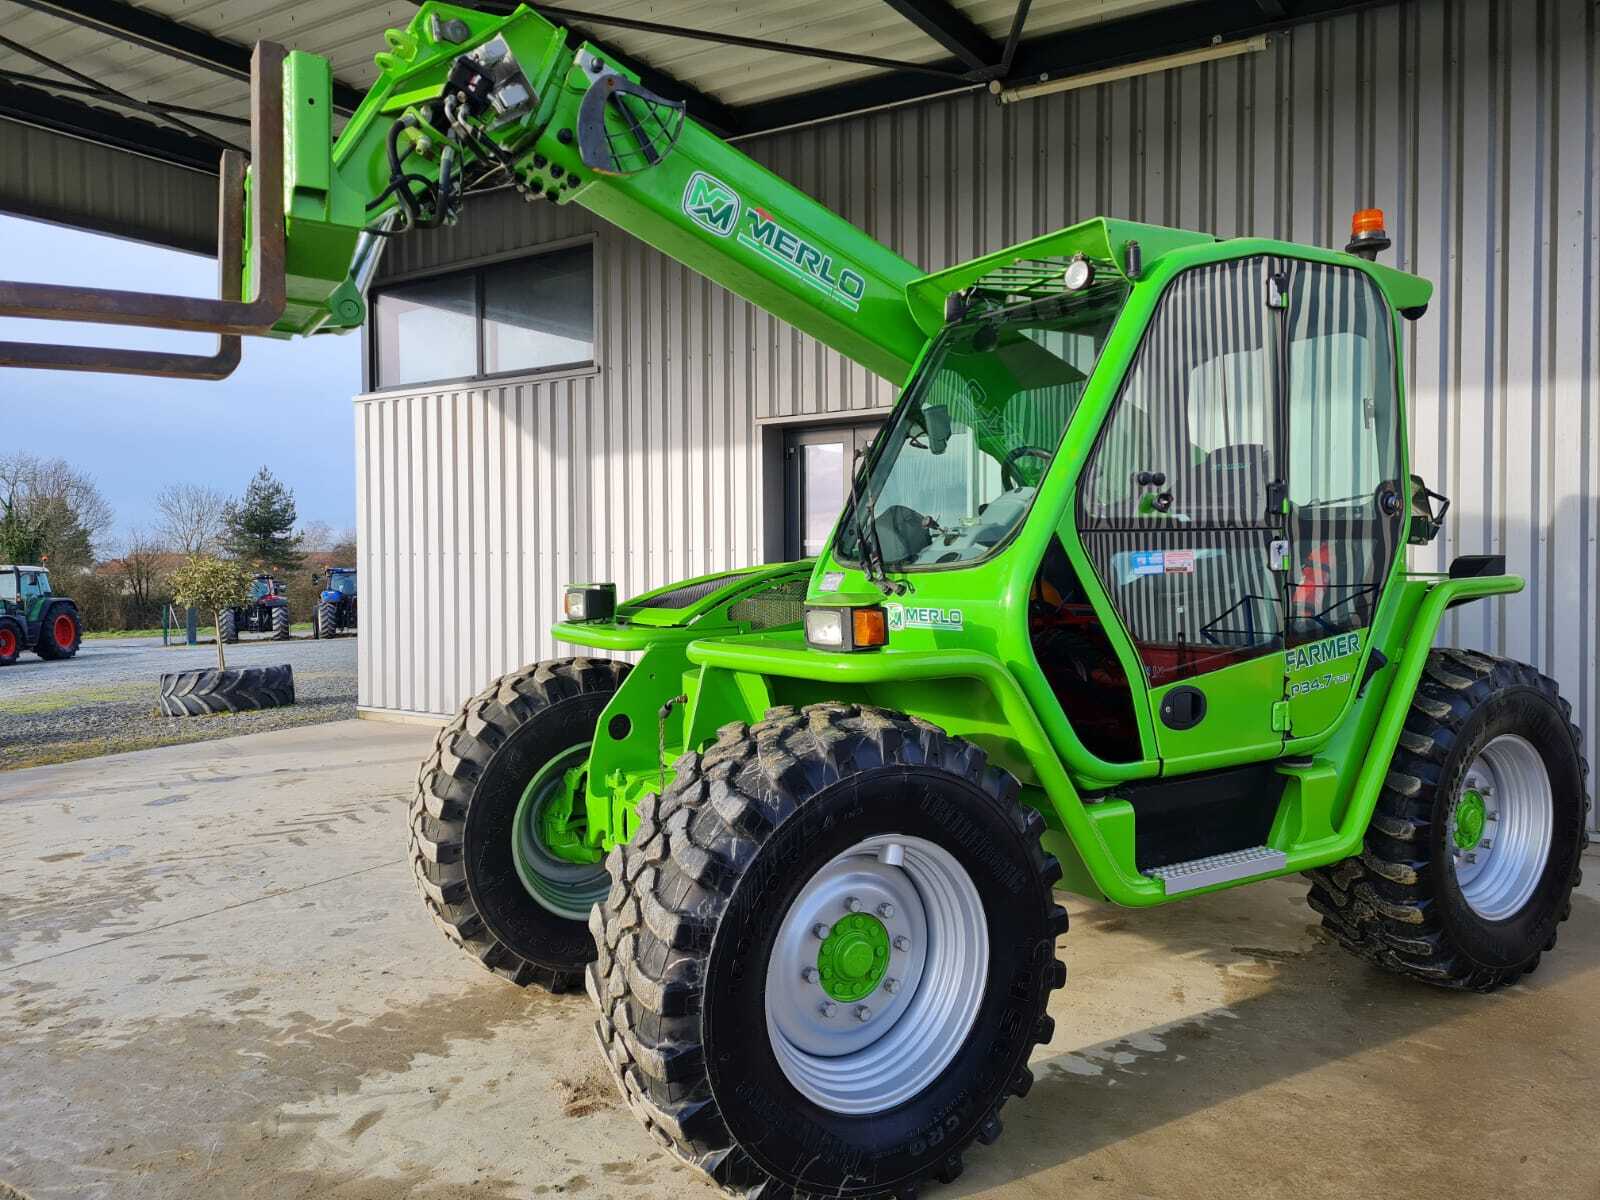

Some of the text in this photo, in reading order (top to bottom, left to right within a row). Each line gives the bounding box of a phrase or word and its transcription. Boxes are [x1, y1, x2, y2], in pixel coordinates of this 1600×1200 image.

[746, 208, 865, 300] MERLO
[905, 608, 963, 624] MERLO
[1285, 633, 1360, 672] FARMER
[1290, 673, 1332, 697] P34.7
